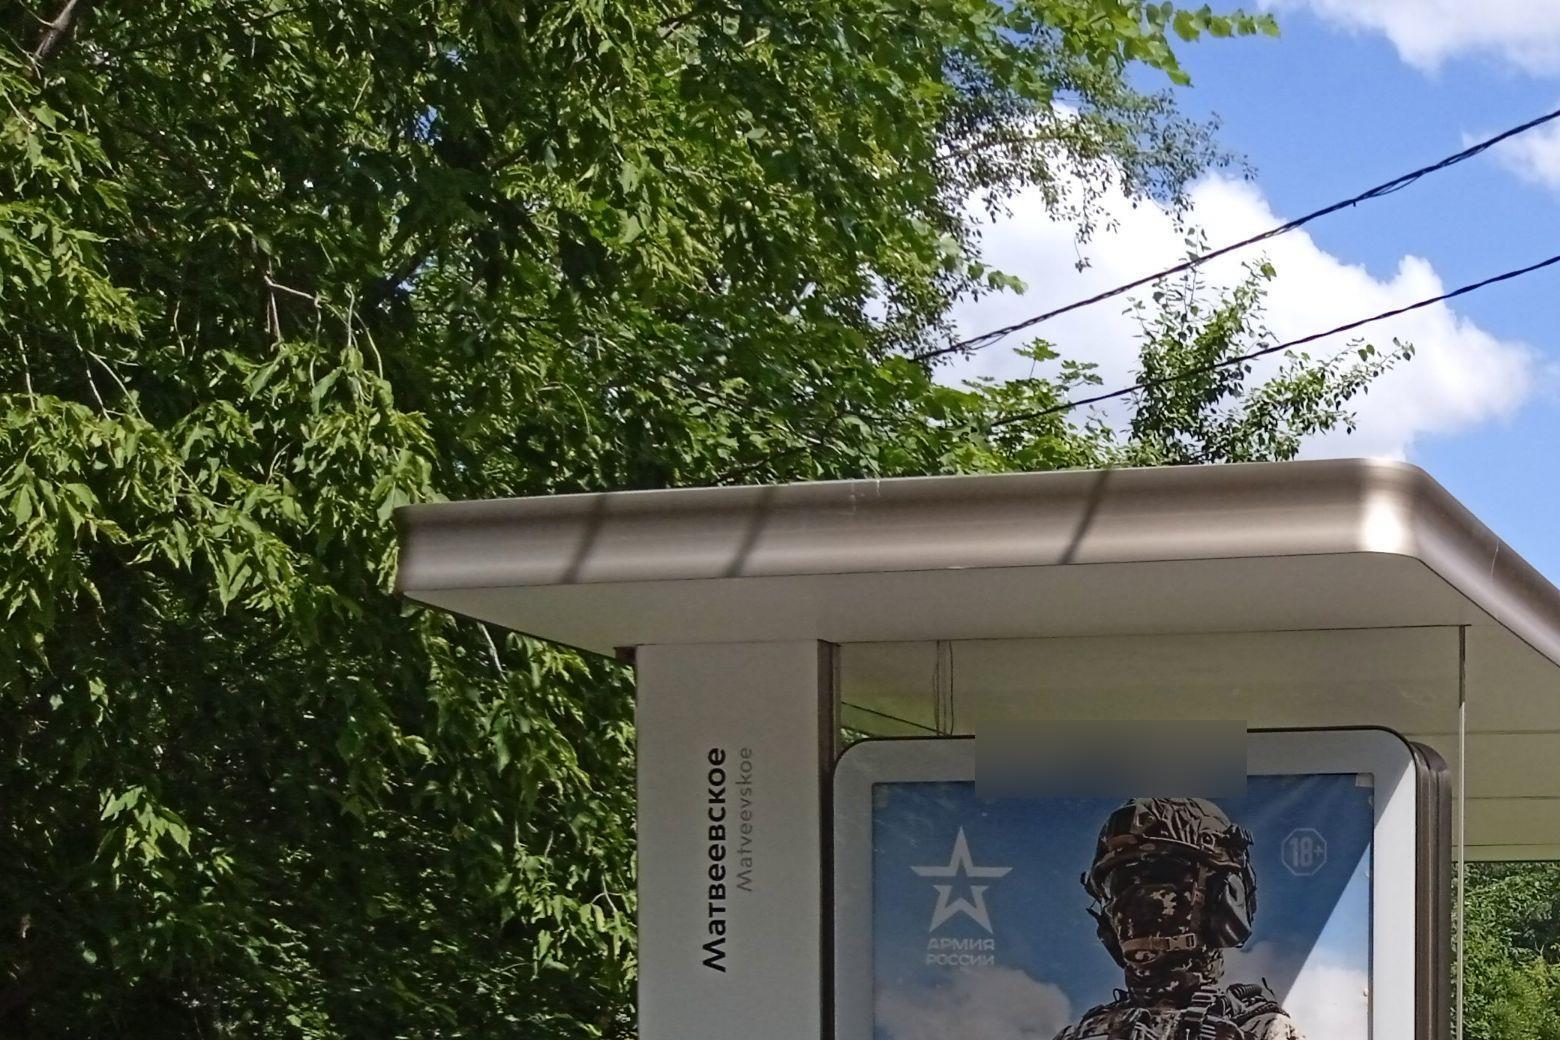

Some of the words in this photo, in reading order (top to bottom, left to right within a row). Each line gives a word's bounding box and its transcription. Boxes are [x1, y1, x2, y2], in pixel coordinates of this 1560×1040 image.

[735, 747, 753, 892] Matveevskoe
[702, 747, 727, 974] Матвеевское
[1290, 837, 1324, 867] 18+
[927, 938, 995, 951] АРМИЯ
[926, 954, 995, 966] РОССИИ
